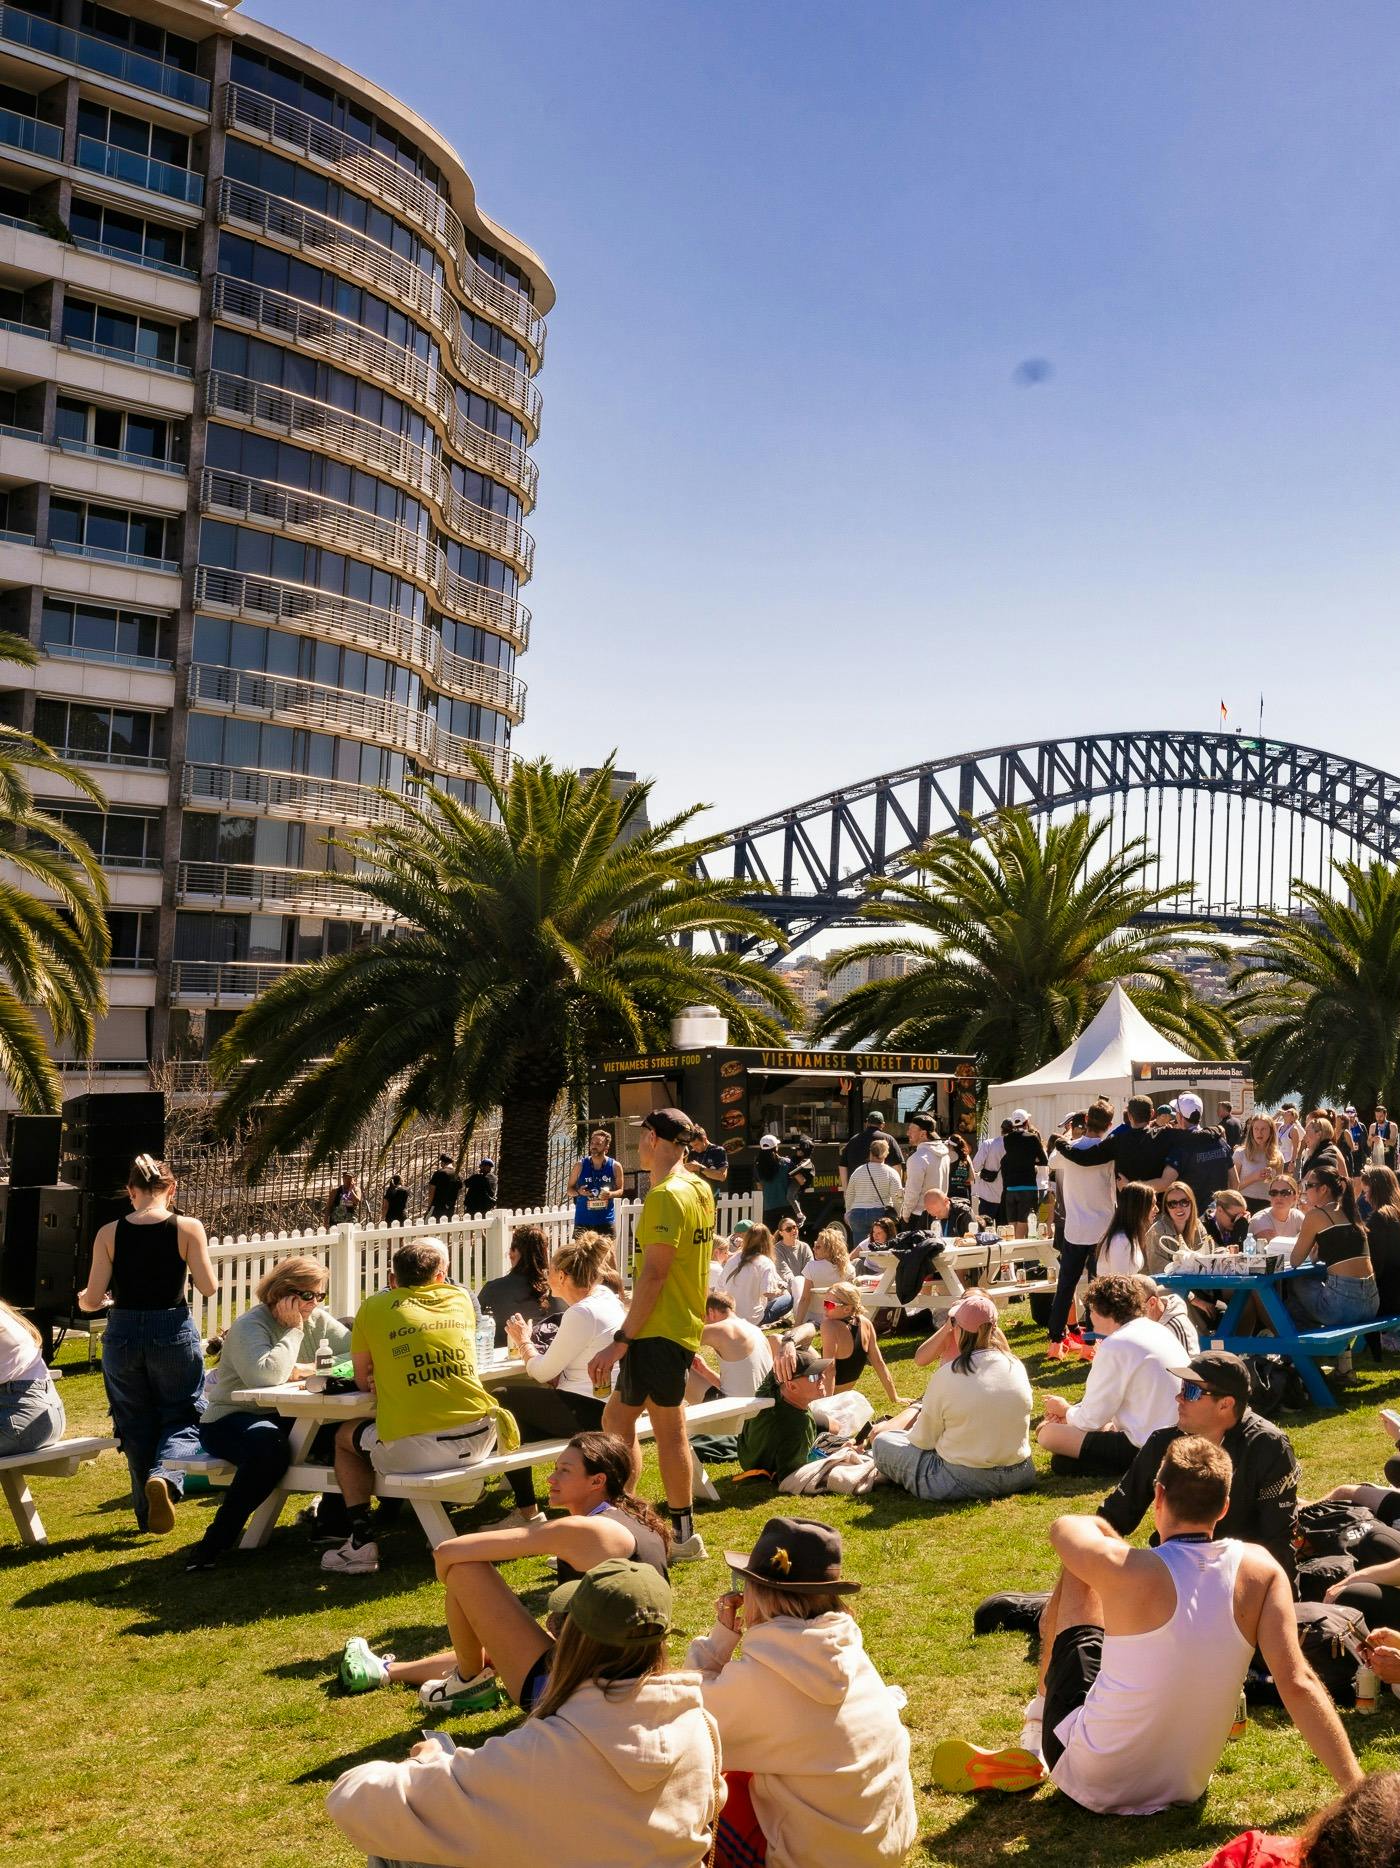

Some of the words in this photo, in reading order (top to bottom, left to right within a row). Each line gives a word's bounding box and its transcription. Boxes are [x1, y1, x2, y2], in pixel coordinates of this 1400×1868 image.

[603, 1059, 648, 1072] VIETNAMESE
[651, 1056, 679, 1068] STREET
[681, 1055, 701, 1065] FOOD
[762, 1052, 847, 1069] VIETNAMESE
[856, 1056, 901, 1070] STREET
[911, 1057, 940, 1071] FOOD
[1156, 1067, 1168, 1075] The
[1169, 1067, 1188, 1076] Better
[1202, 1067, 1231, 1076] Marathon
[412, 1348, 466, 1368] BLIND
[406, 1364, 476, 1387] RUNNER
